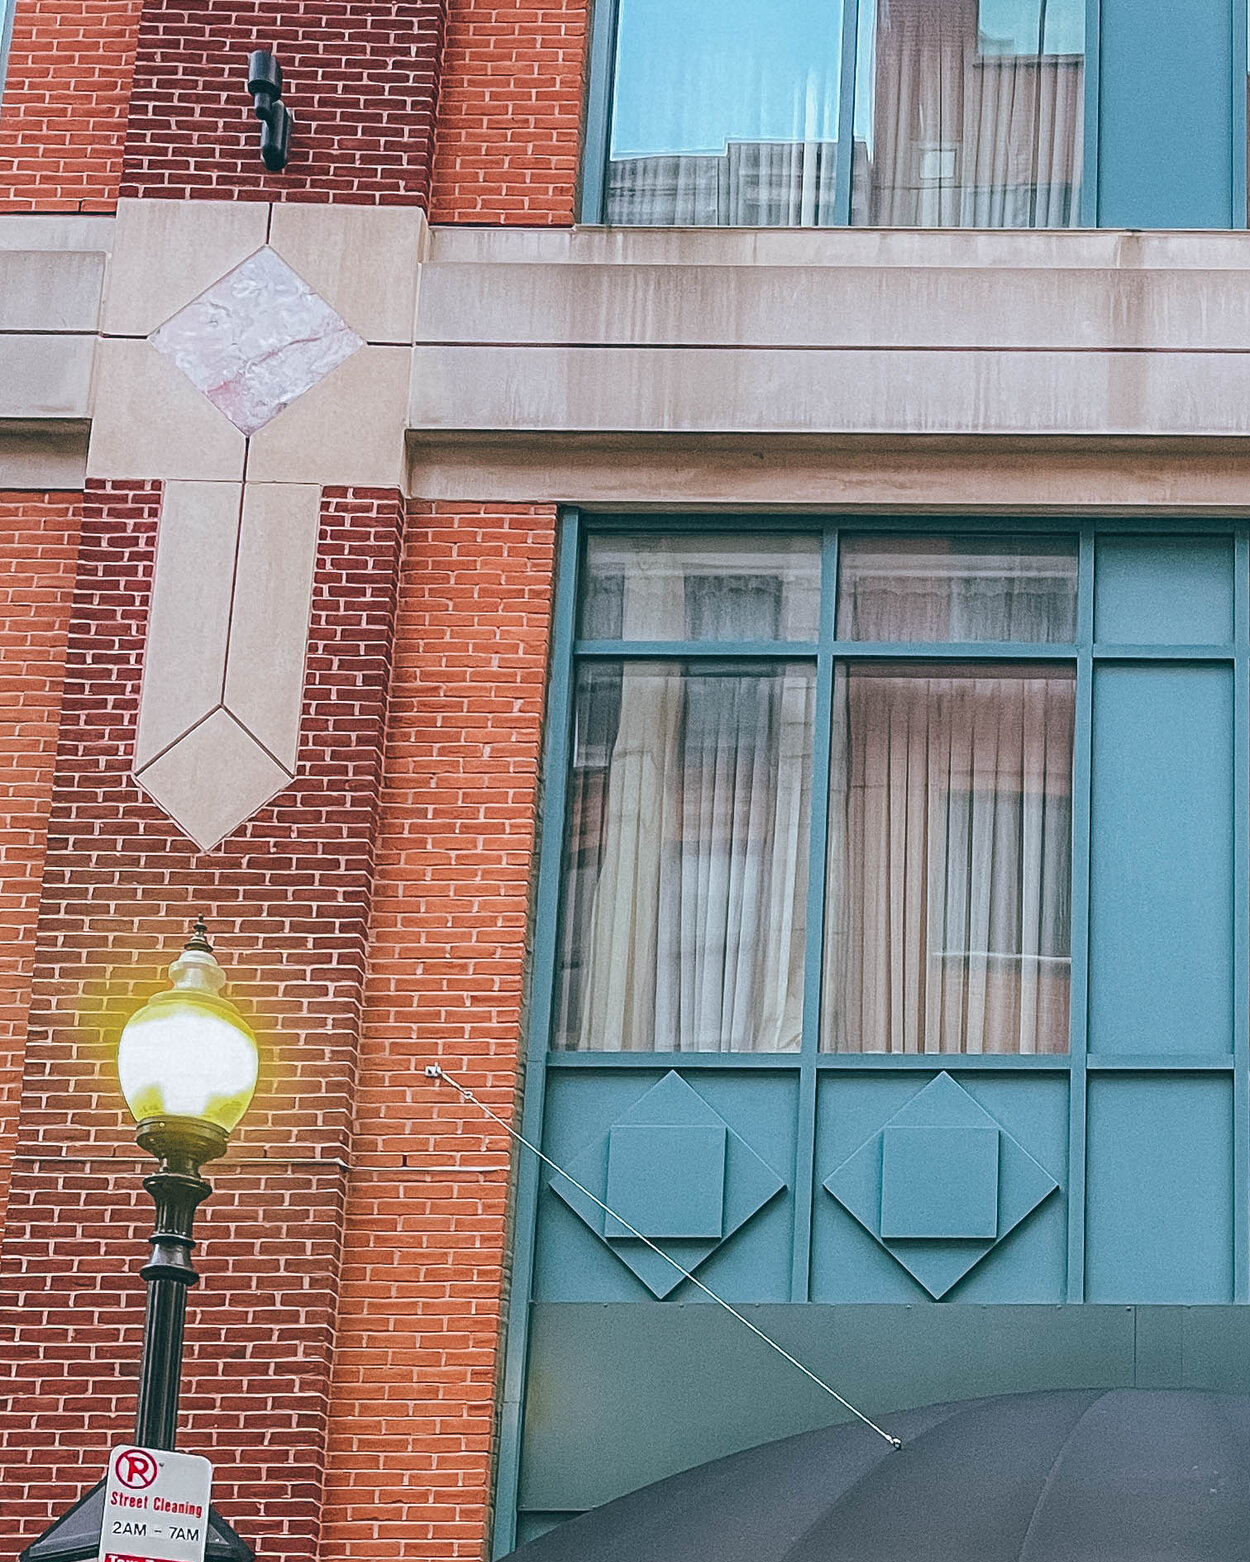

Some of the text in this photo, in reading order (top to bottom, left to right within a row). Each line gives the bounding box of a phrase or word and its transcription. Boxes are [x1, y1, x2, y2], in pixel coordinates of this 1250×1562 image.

[111, 1491, 202, 1518] Street Cleaning
[112, 1521, 147, 1536] 2AM
[169, 1526, 199, 1541] 7AM
